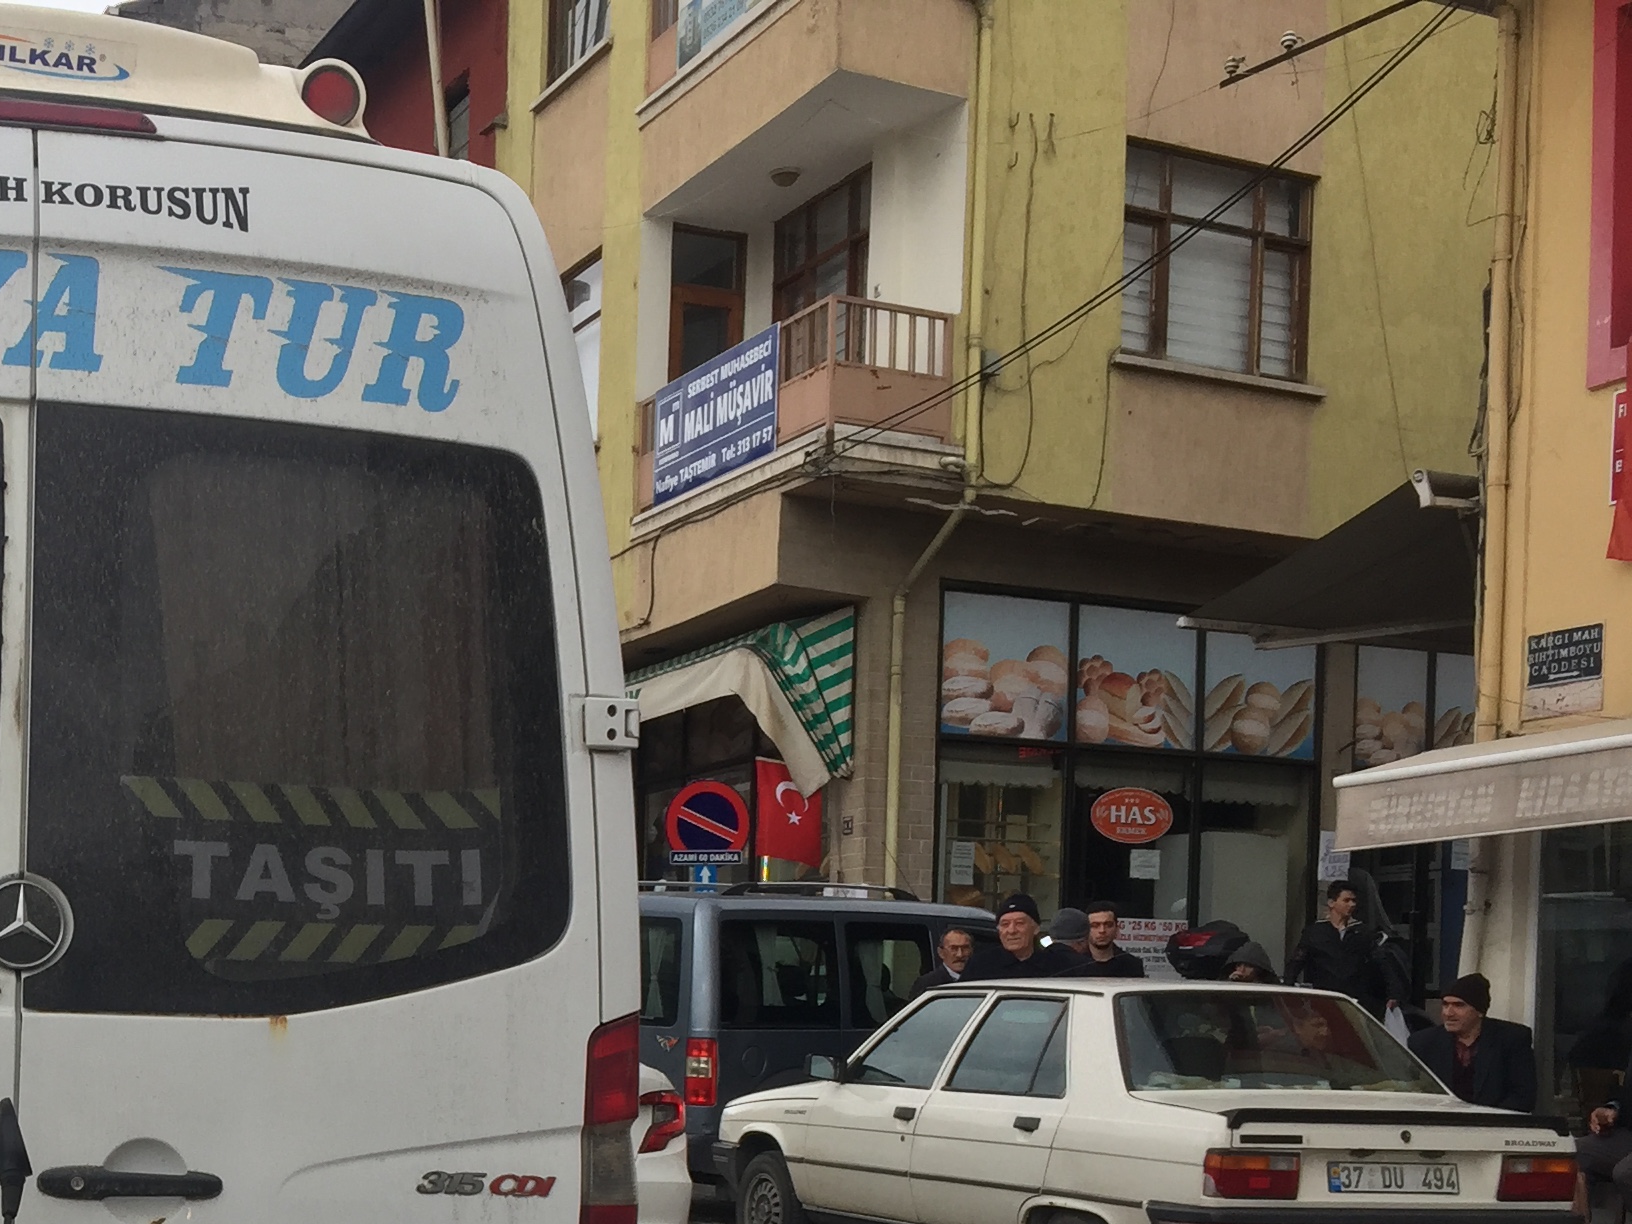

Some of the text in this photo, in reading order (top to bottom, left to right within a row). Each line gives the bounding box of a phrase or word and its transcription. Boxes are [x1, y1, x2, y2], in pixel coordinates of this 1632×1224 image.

[40, 178, 251, 234] KORUSUN
[156, 265, 465, 414] TUR
[687, 335, 773, 398] SERBEST MUHASEBECİ
[684, 364, 774, 444] MALİ MÜŞAVİR
[655, 473, 678, 495] Nafiye
[679, 451, 717, 483] TAŞTEMİR
[721, 444, 736, 463] Tel:
[736, 435, 751, 456] 313
[752, 432, 762, 450] 17
[762, 425, 773, 445] 57
[1530, 627, 1600, 650] KARGI MAH
[1528, 642, 1601, 665] RIHTIMBOYU
[1531, 657, 1595, 676] CADDESI
[1110, 805, 1157, 825] HAS
[672, 852, 739, 862] AZAMİ 60 DAKİKA
[173, 839, 484, 920] TAŞITI
[1144, 921, 1156, 931] KG
[1503, 1138, 1558, 1148] BROADWAY
[416, 1170, 557, 1198] 315 CDI
[1341, 1165, 1364, 1189] 37
[1381, 1166, 1405, 1189] DU
[1421, 1166, 1457, 1191] 494
